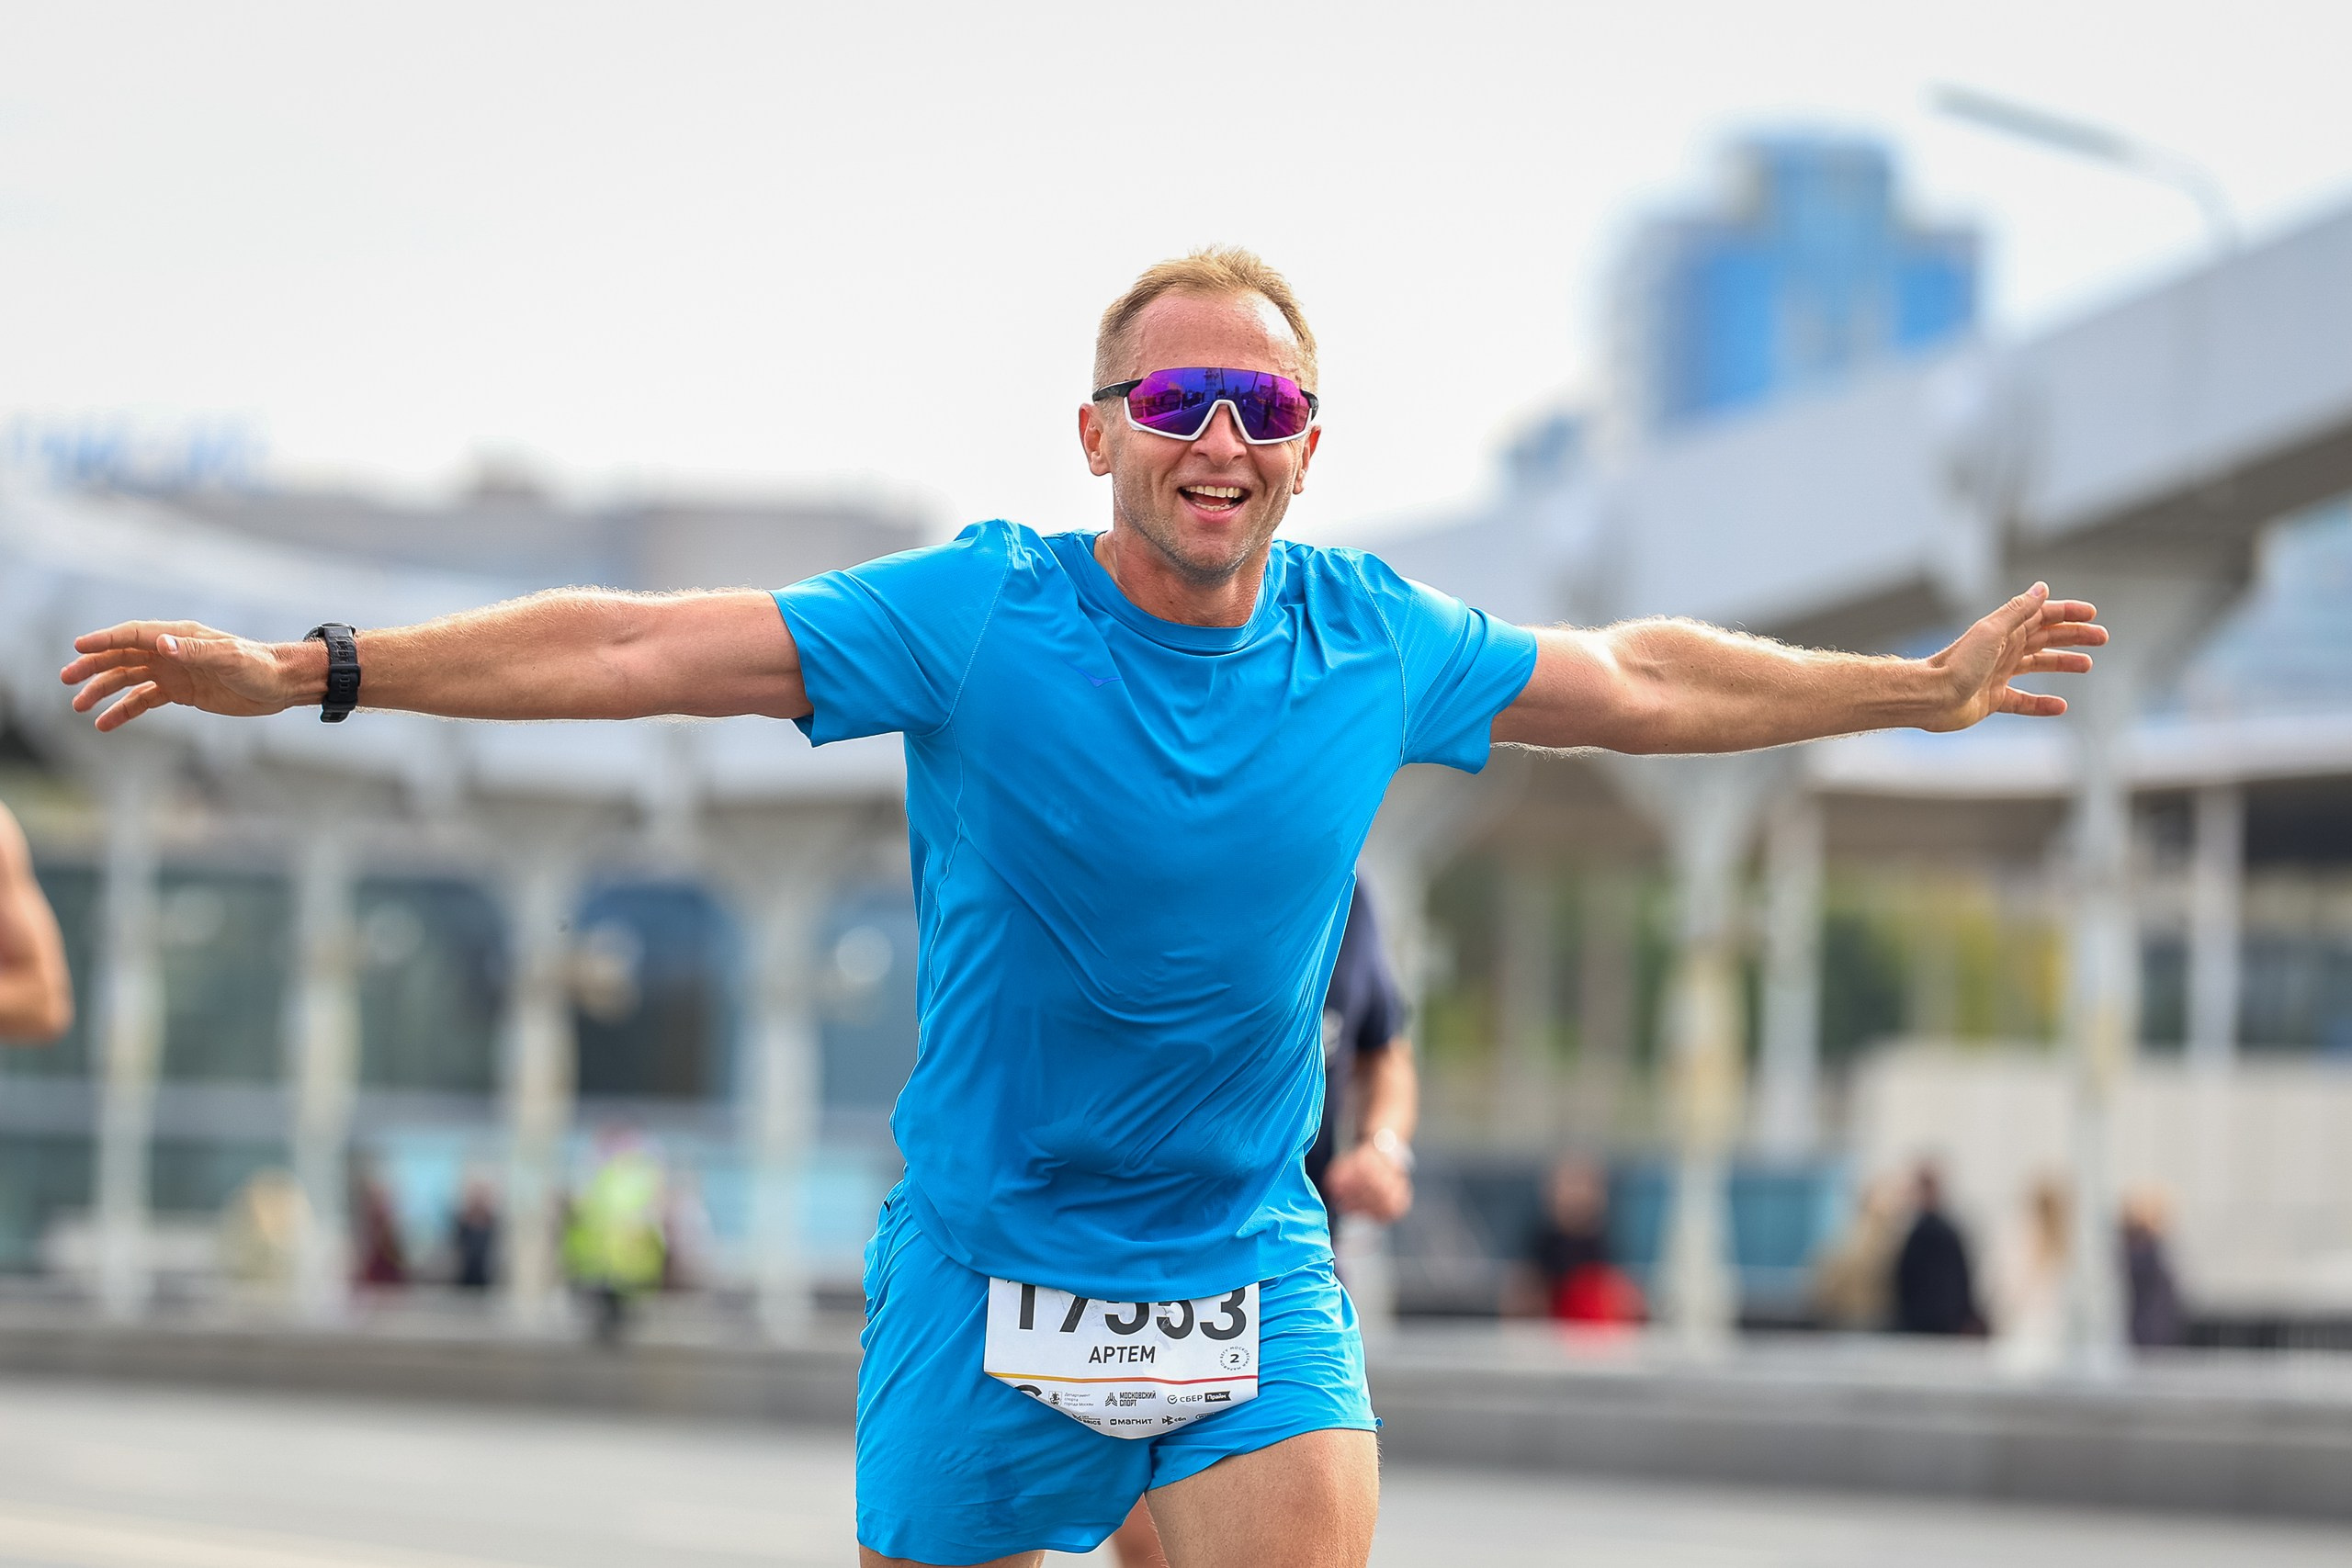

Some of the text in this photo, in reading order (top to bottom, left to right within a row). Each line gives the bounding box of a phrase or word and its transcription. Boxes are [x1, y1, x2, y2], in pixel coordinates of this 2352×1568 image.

[1088, 1345, 1156, 1364] АРТЕМ
[1230, 1353, 1239, 1364] 2
[1119, 1390, 1157, 1400] МОСКОВСКИЙ
[1179, 1394, 1203, 1403] СБЕР
[1119, 1399, 1137, 1407] СПОРТ
